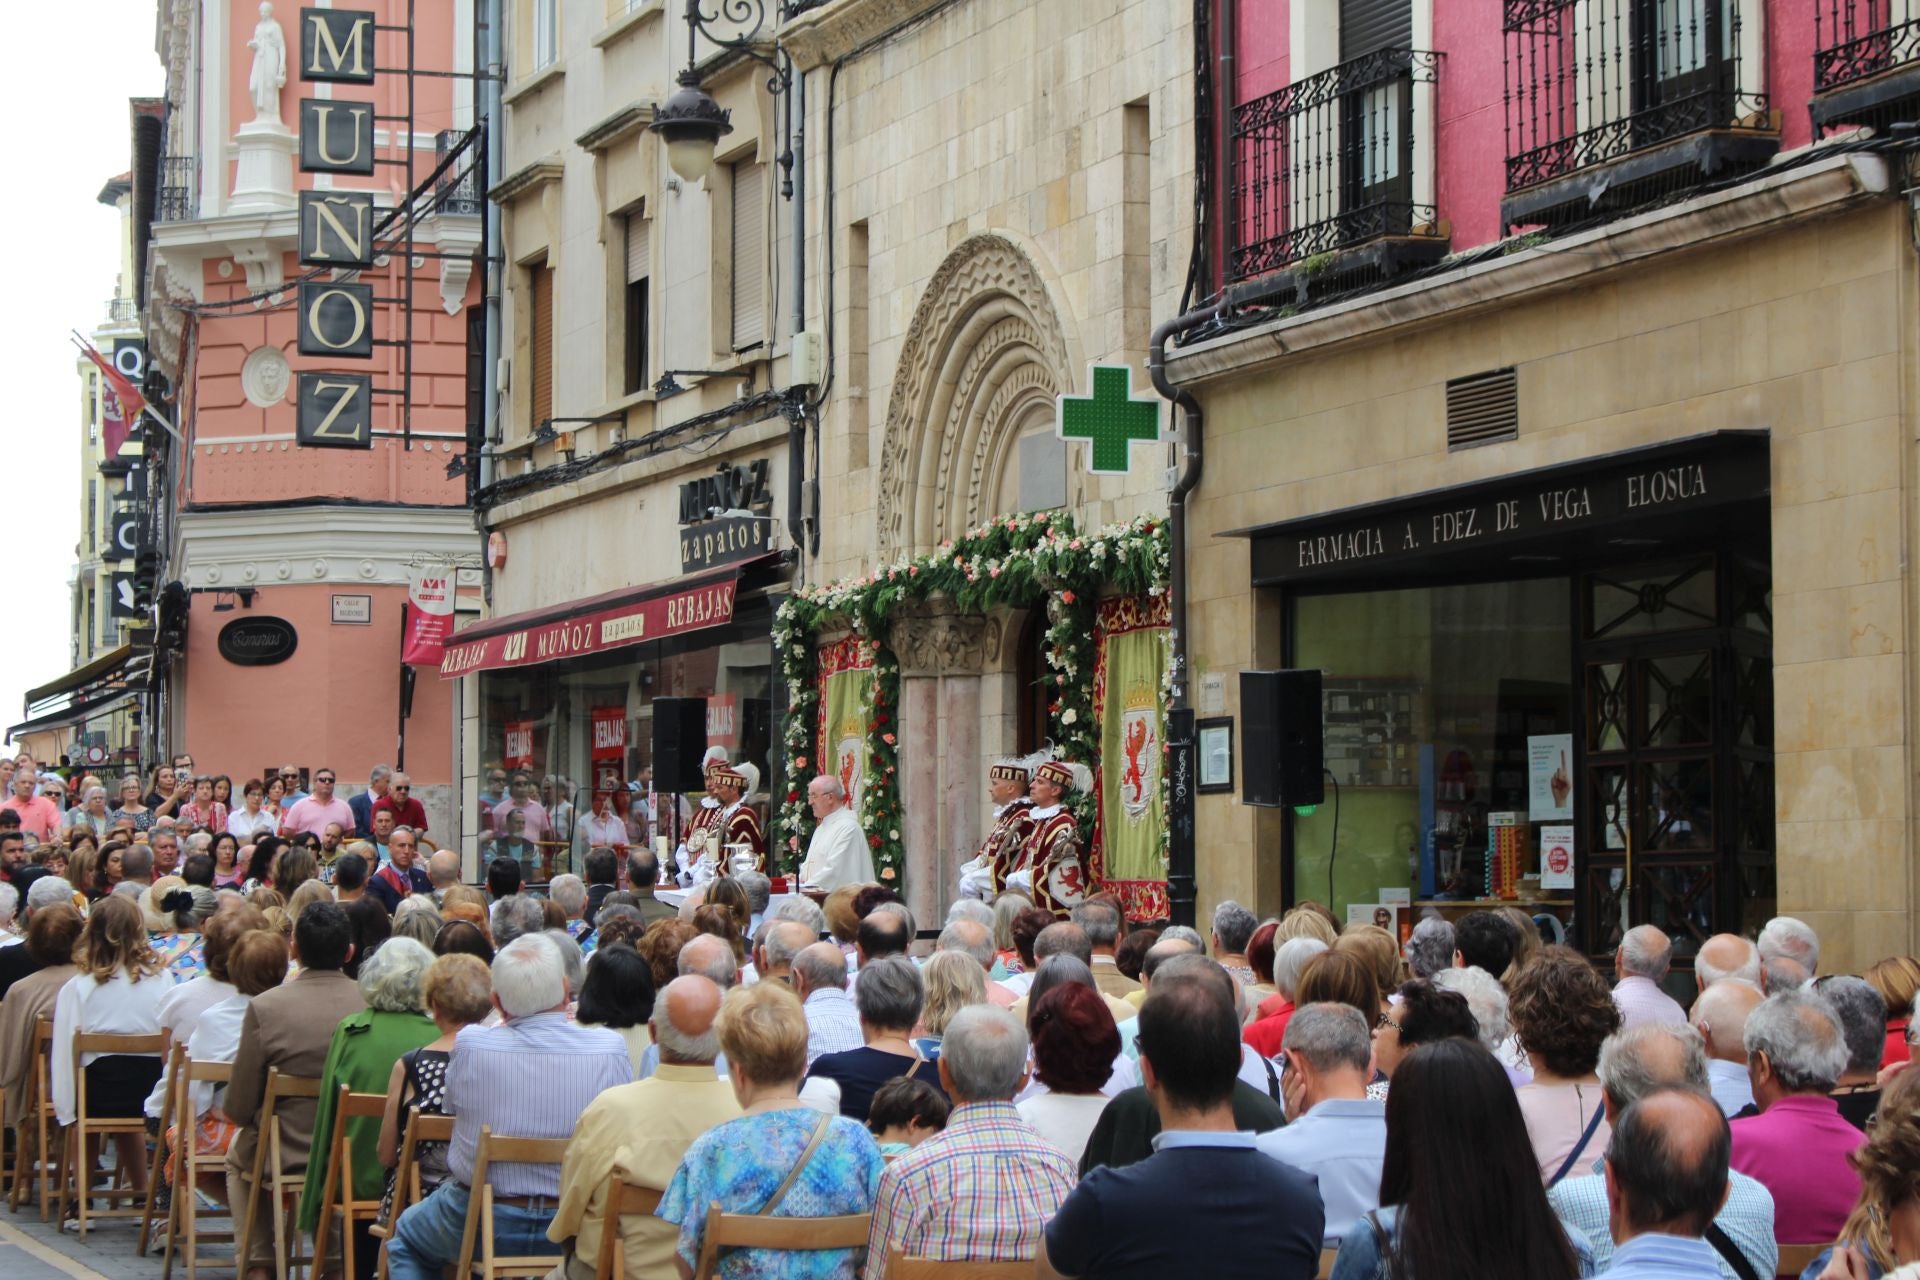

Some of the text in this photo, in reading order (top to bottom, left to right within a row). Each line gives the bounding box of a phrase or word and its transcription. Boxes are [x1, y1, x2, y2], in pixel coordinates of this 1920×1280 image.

[308, 15, 371, 442] MUÑOZ
[1298, 463, 1707, 568] FARMACIA A. FDEZ. DE VEGA ELOSUA
[681, 520, 761, 564] zapatos
[232, 629, 281, 648] Canarias
[440, 642, 488, 674] REBAJAS
[536, 621, 594, 658] MUÑOZ
[666, 585, 733, 629] REBAJAS
[595, 719, 624, 749] REBAJAS
[706, 705, 733, 737] EBAJAS
[506, 729, 532, 758] REBAJAS
